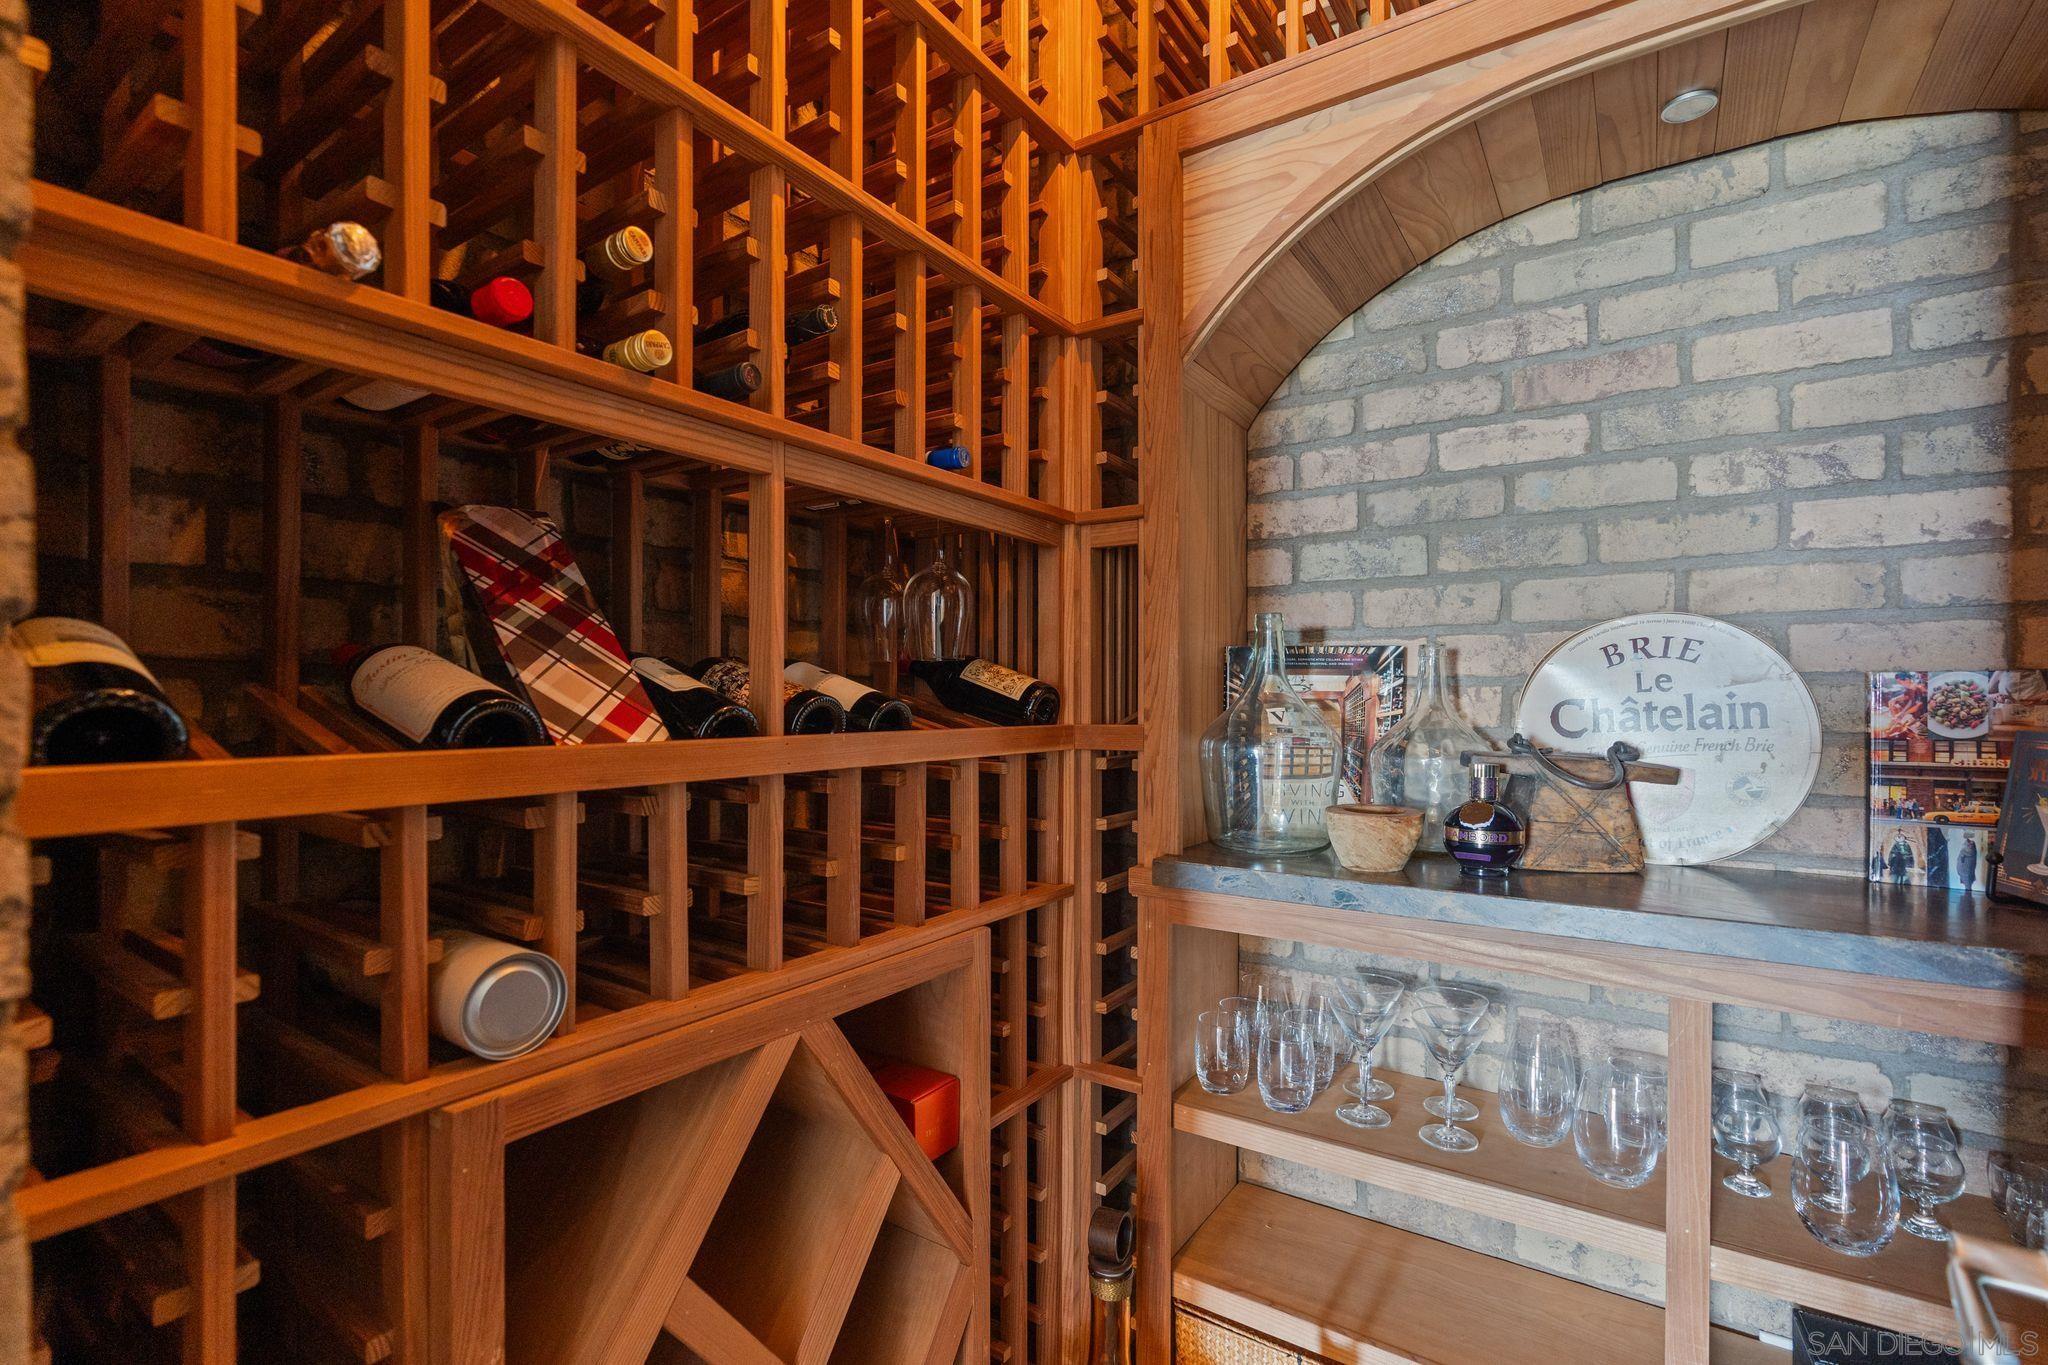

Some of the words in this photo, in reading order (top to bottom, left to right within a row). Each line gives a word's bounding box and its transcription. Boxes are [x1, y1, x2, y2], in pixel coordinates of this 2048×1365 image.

[1599, 635, 1705, 669] BRIE
[1636, 671, 1673, 693] Le
[1550, 691, 1770, 739] Châtelain
[1694, 737, 1741, 753] French
[1745, 737, 1775, 754] Brie
[1446, 828, 1508, 843] AMBORD
